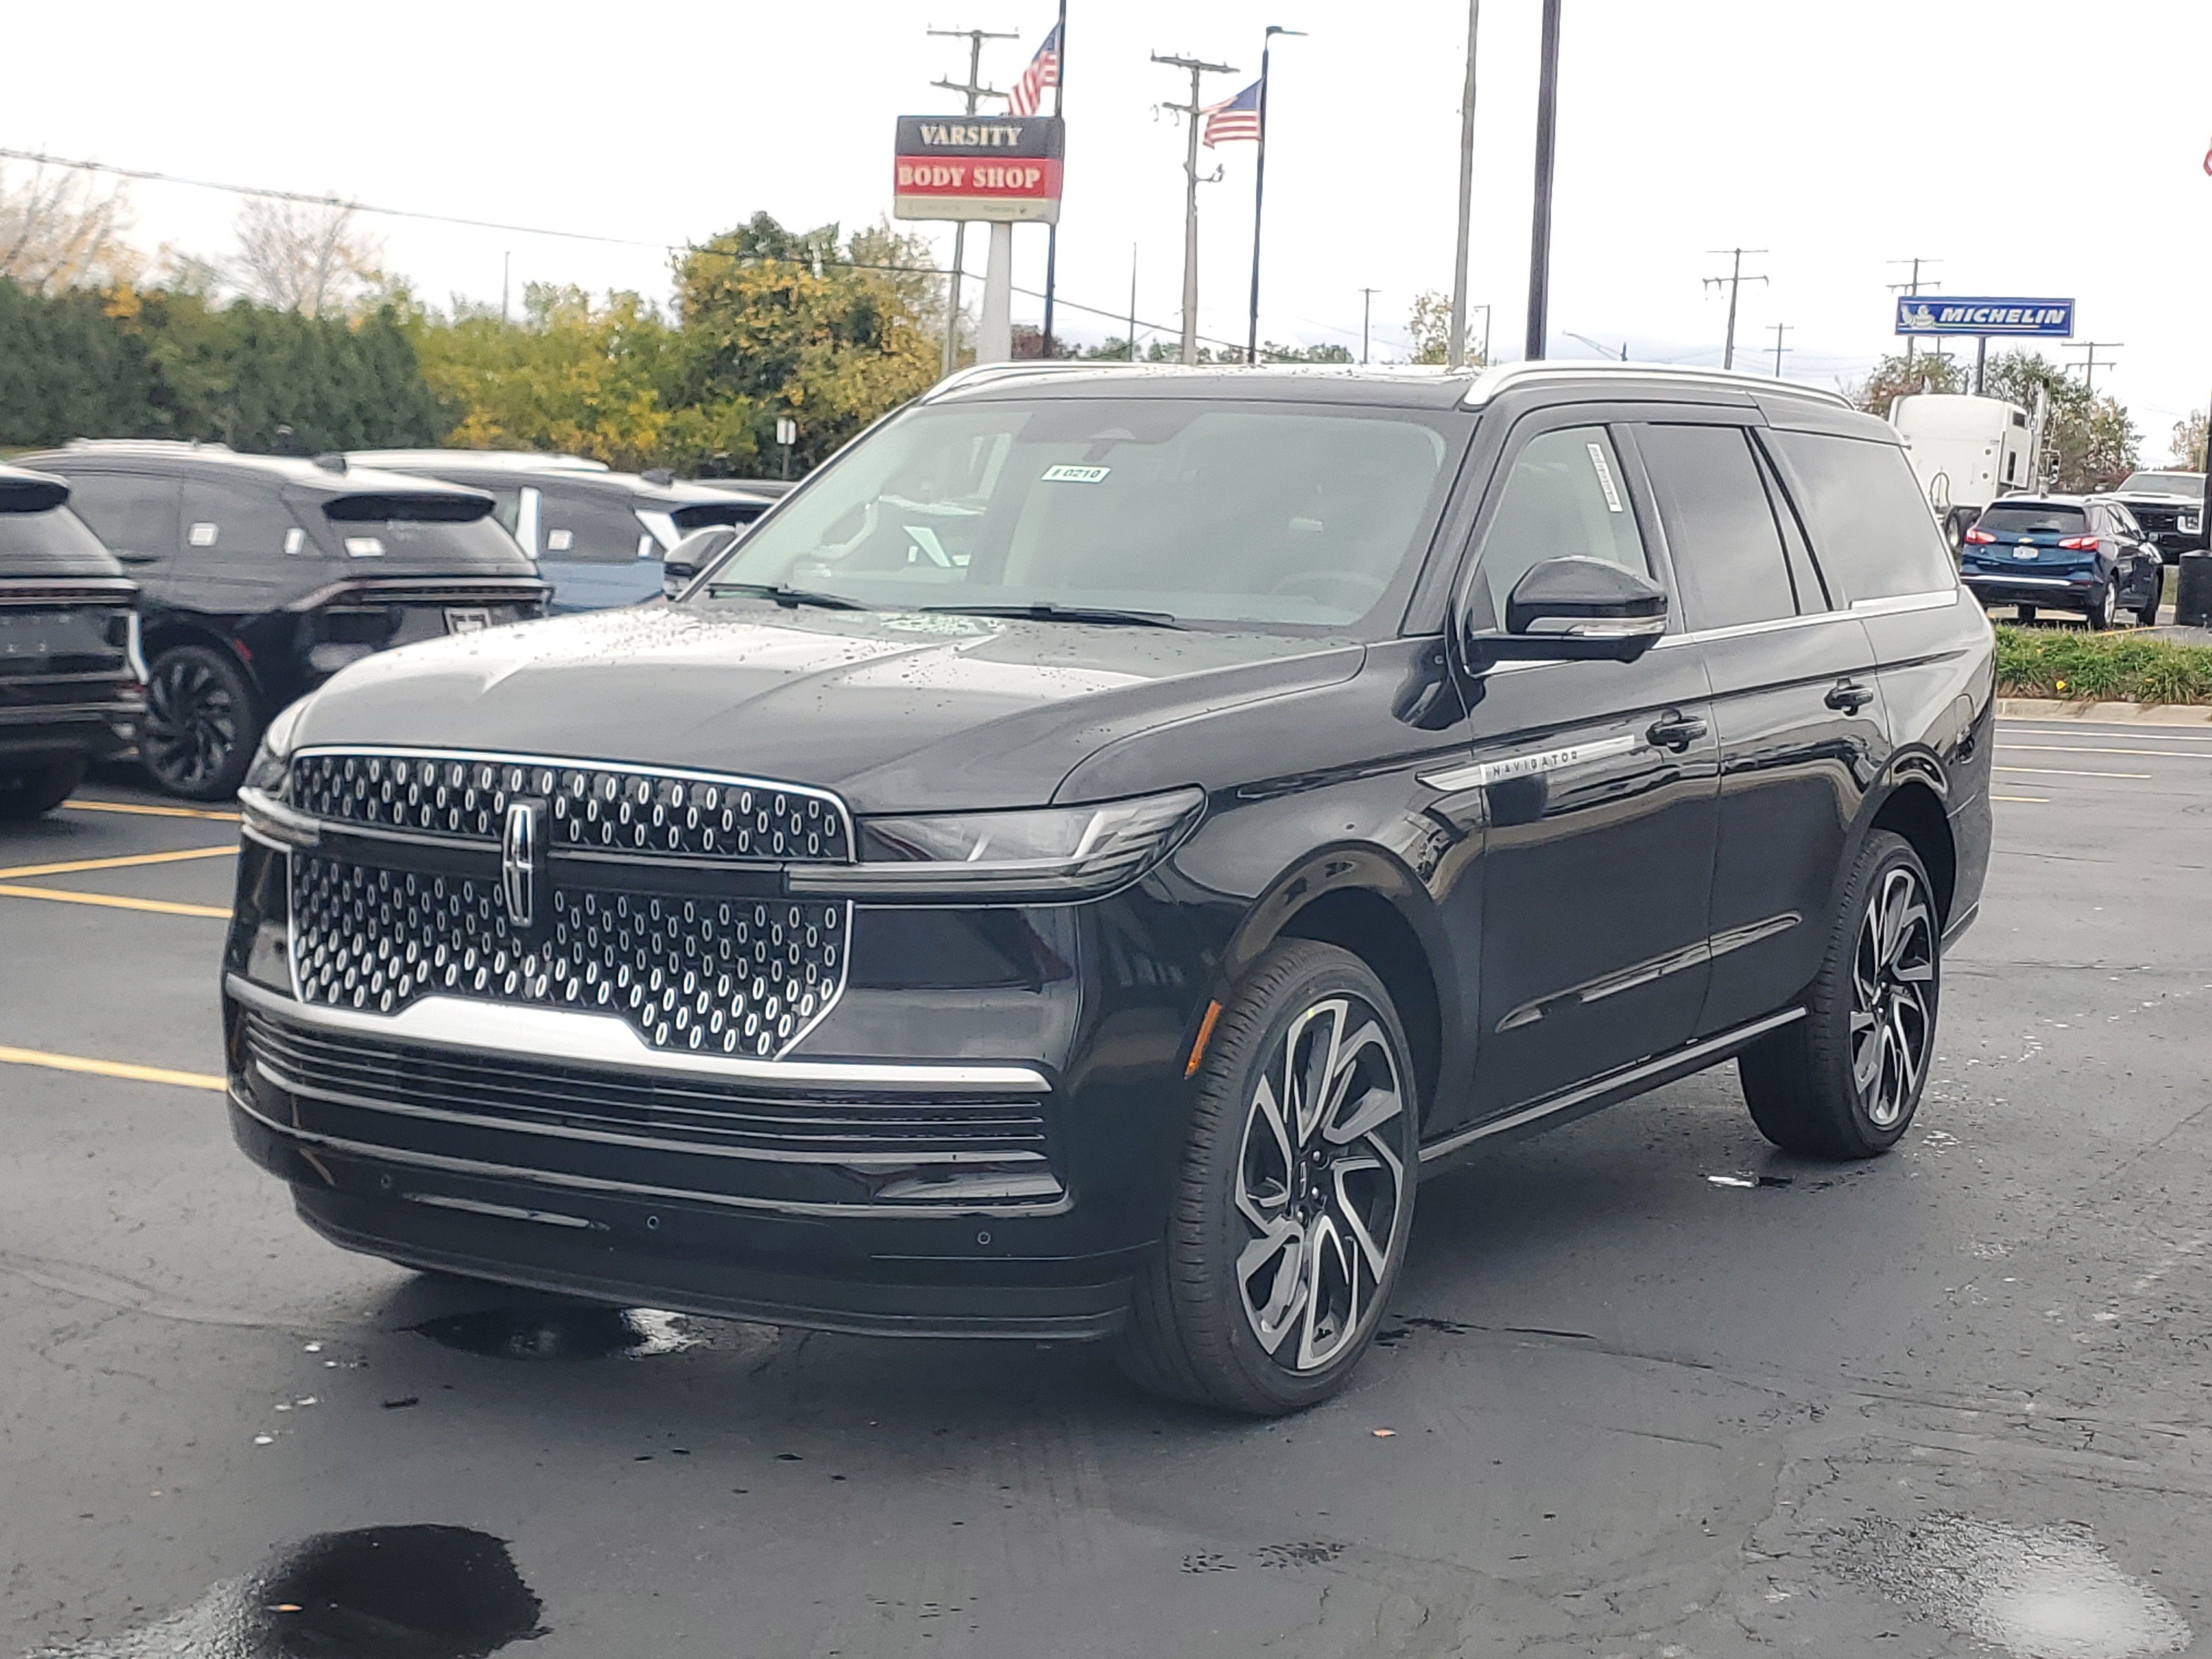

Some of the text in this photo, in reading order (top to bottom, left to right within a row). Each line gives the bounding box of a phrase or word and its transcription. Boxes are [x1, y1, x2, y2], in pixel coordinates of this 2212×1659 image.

[921, 125, 1023, 146] VARSITY
[898, 166, 1041, 189] BODY SHOP
[1939, 307, 2066, 324] MICHELIN
[1493, 751, 1578, 777] NAVIGATOR
